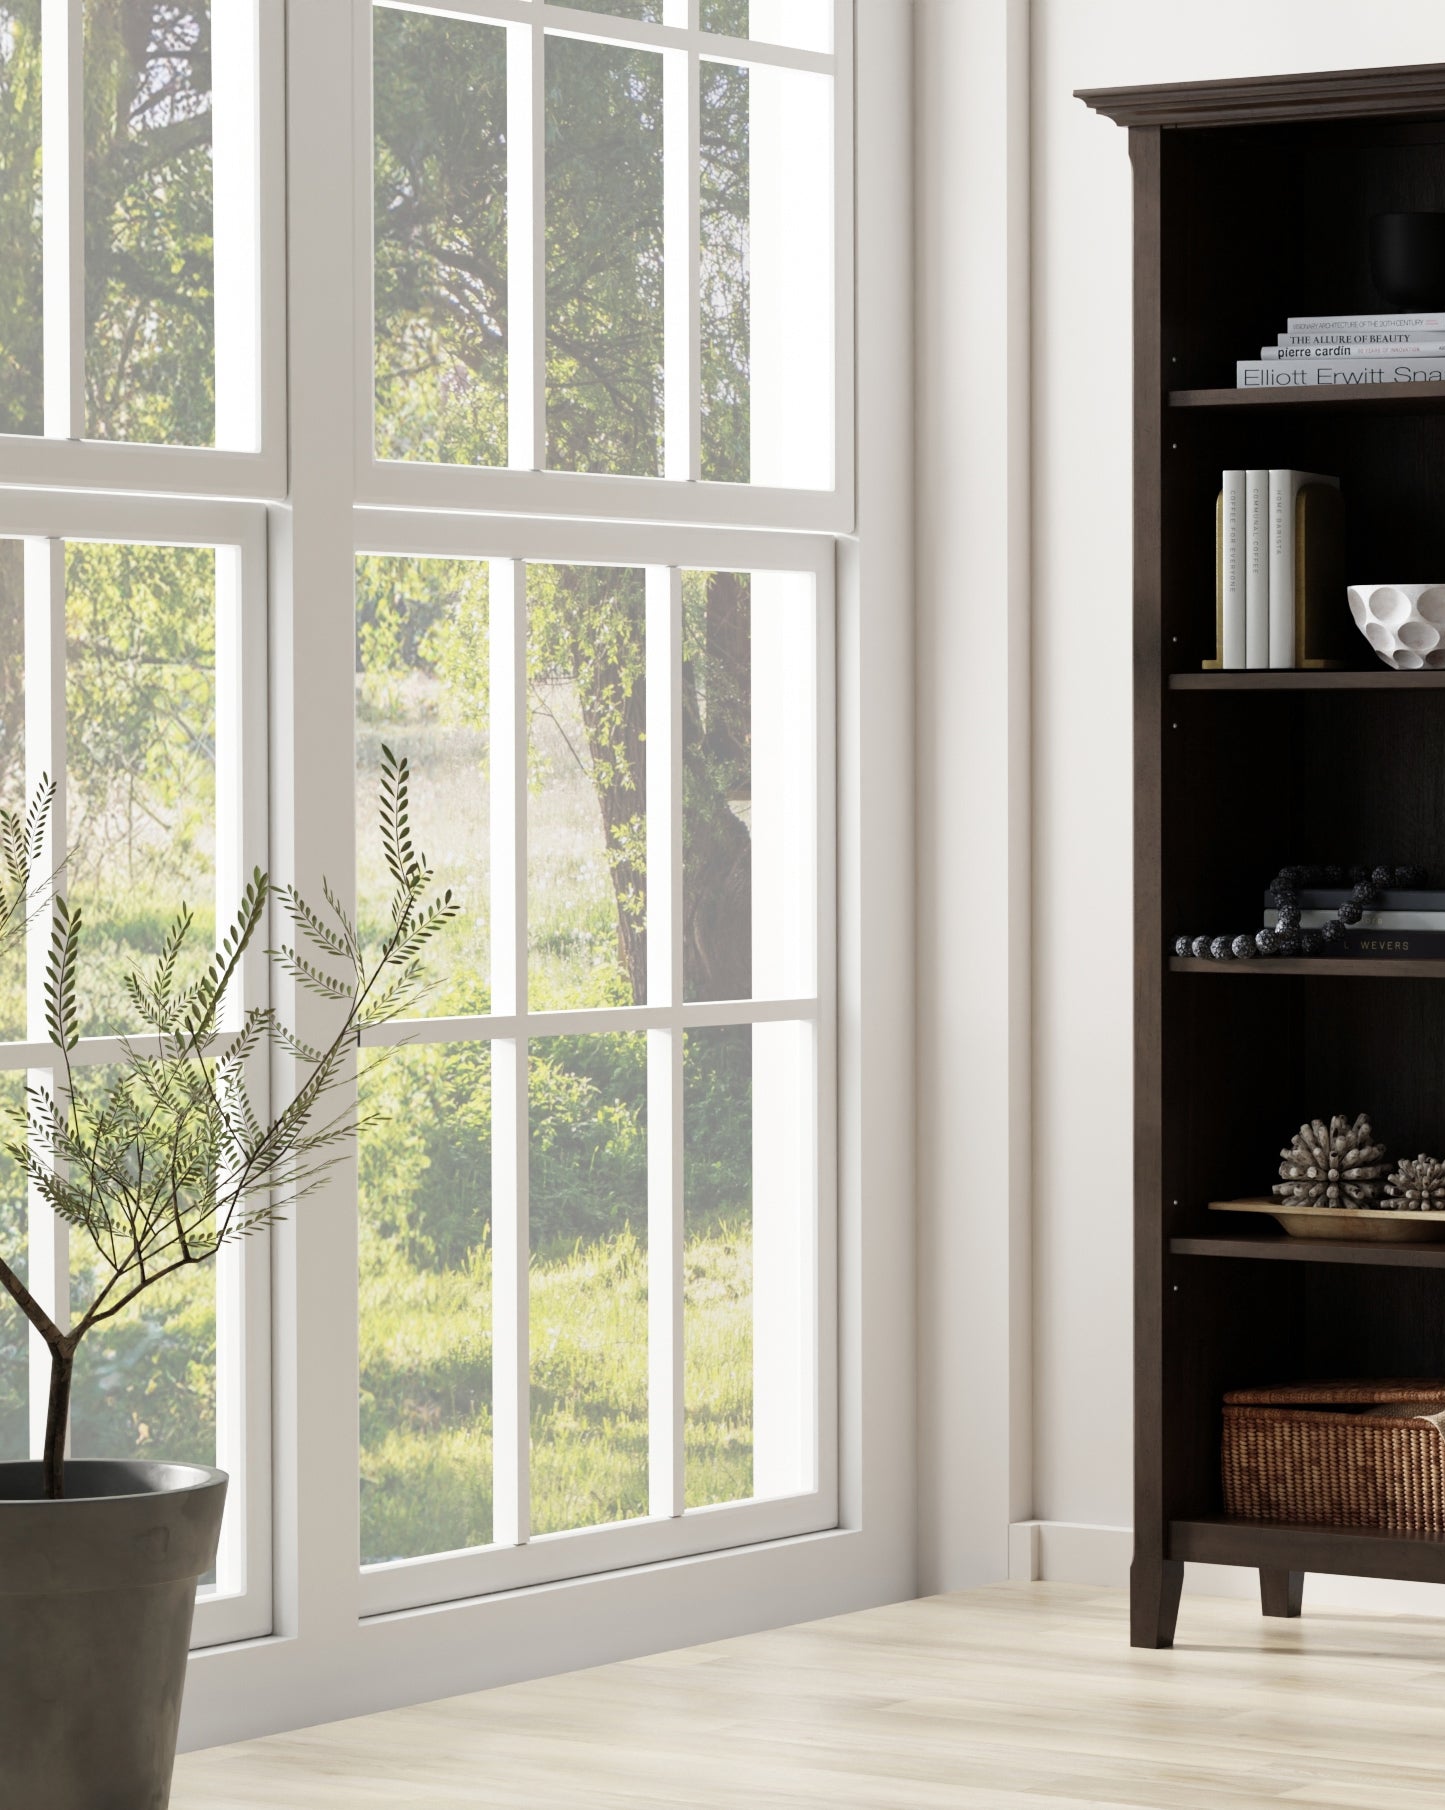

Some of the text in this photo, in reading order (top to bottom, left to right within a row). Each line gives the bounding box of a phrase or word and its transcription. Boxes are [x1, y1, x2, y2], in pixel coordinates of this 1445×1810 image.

[1290, 334, 1411, 344] THE ALLURE OF BEAUTY
[1278, 348, 1311, 360] pierre
[1315, 345, 1351, 357] cardin
[1244, 368, 1308, 386] Elliott
[1317, 367, 1385, 385] Erwitt
[1360, 940, 1409, 951] WEVERS
